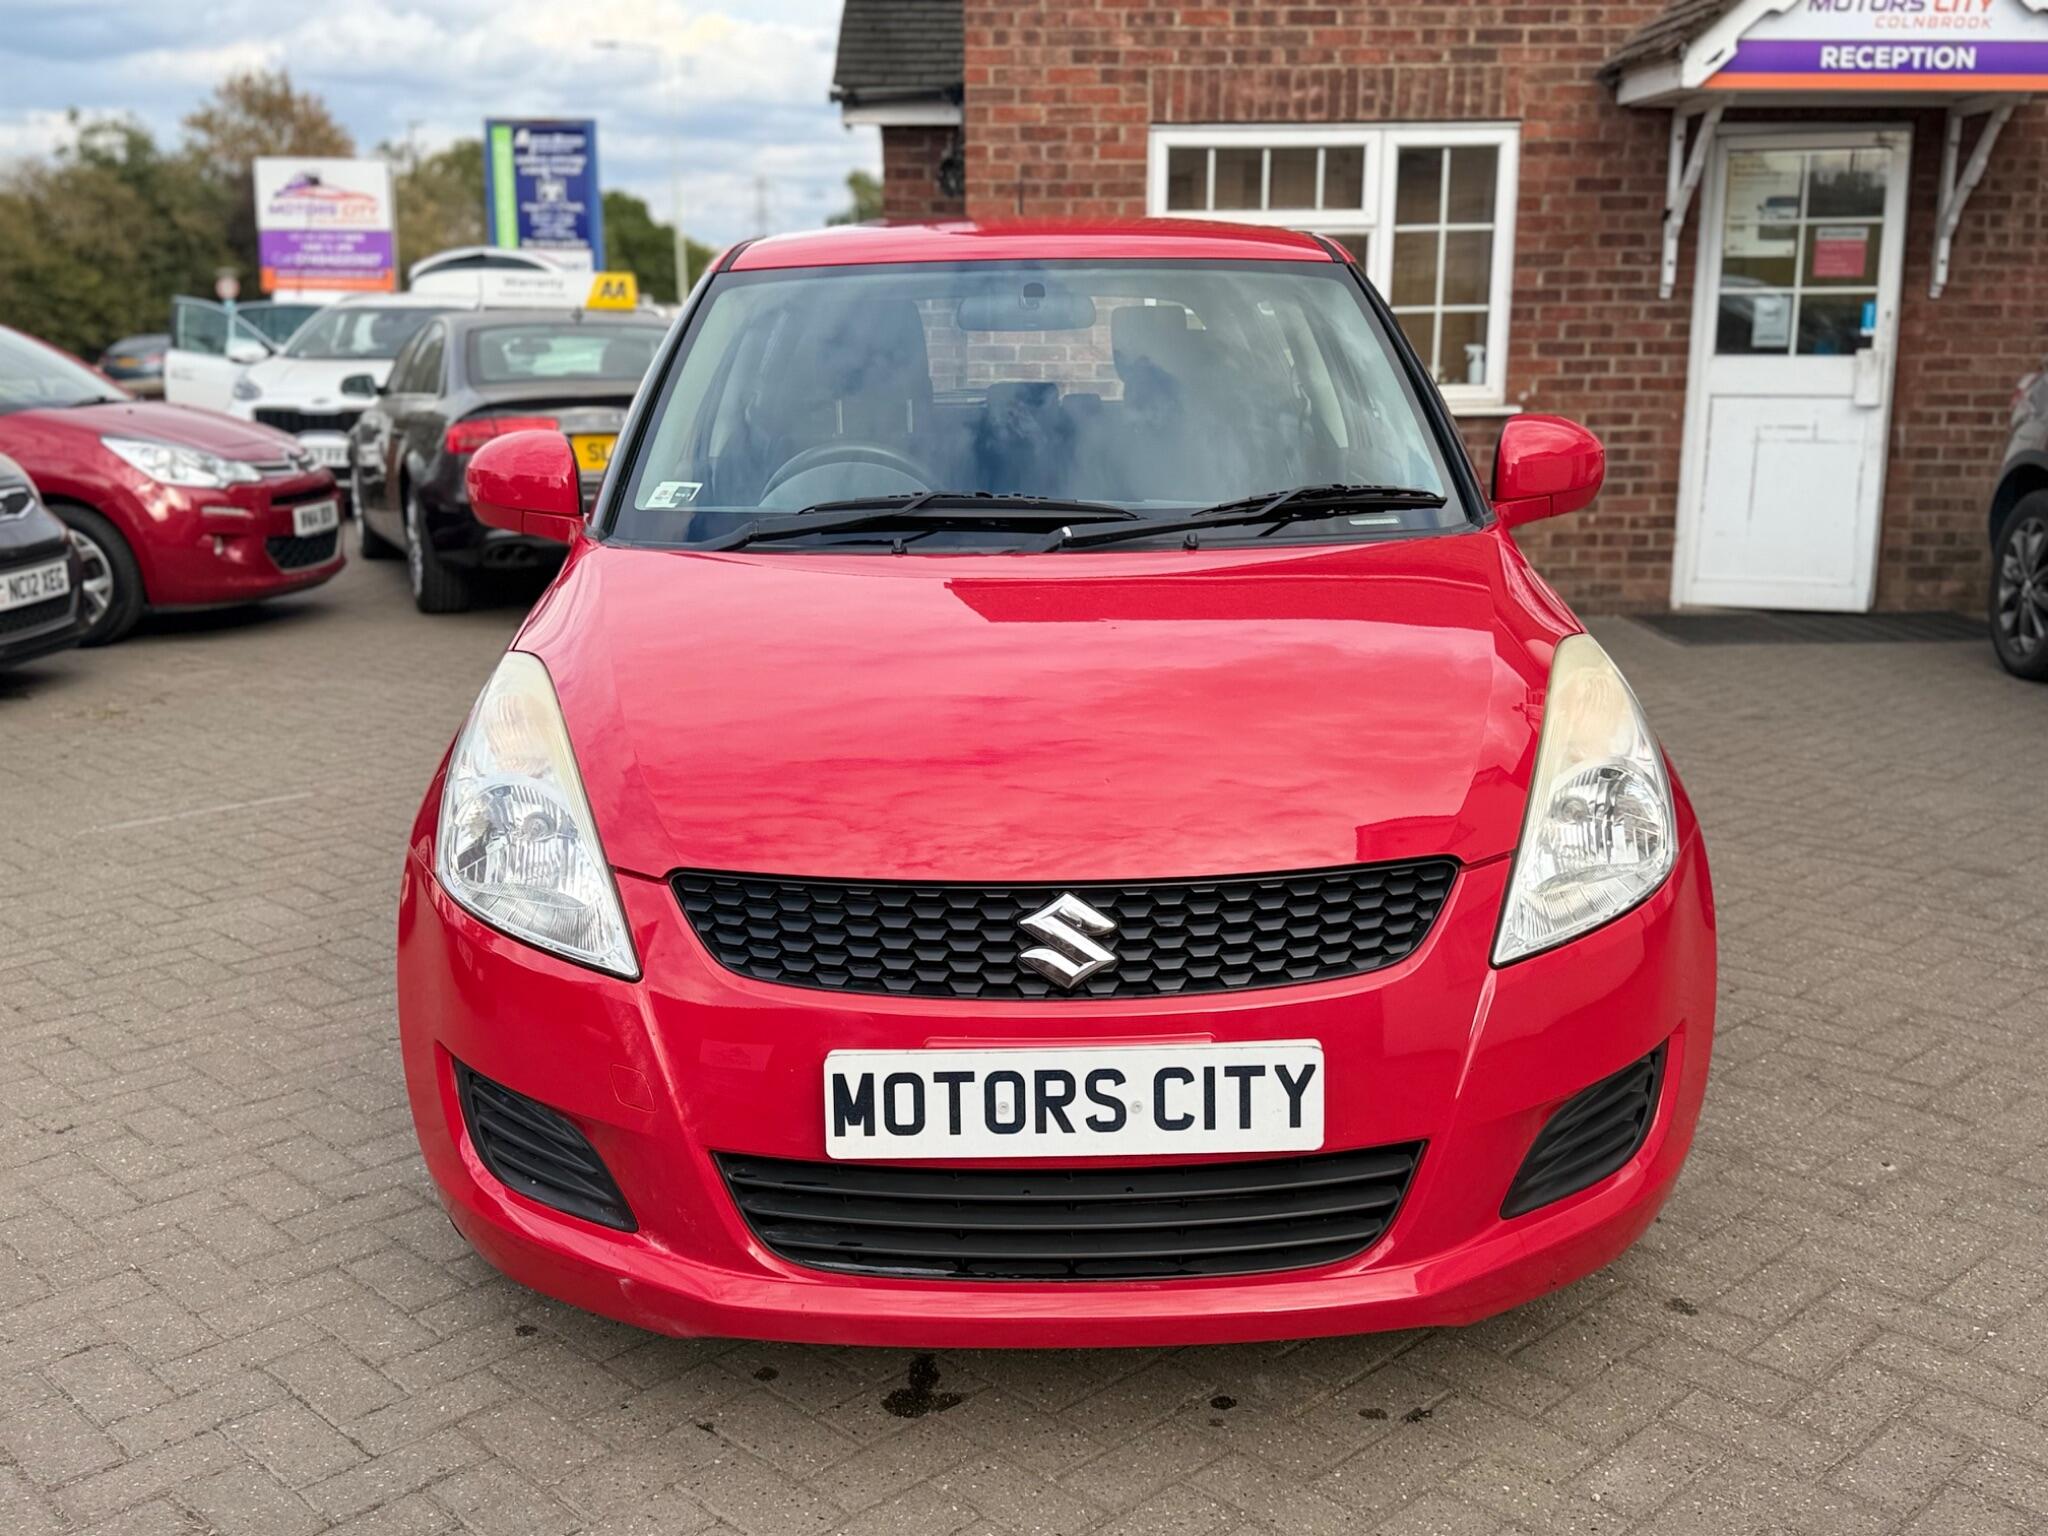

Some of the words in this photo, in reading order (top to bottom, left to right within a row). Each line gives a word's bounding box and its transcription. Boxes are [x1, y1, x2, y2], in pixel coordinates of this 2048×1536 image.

[1874, 15, 1992, 29] COLNBROOK
[1820, 46, 1977, 69] RECEPTION
[601, 279, 627, 298] AA
[8, 572, 39, 602] NC12
[832, 1068, 1127, 1137] MOTORS
[1153, 1064, 1317, 1131] CITY
